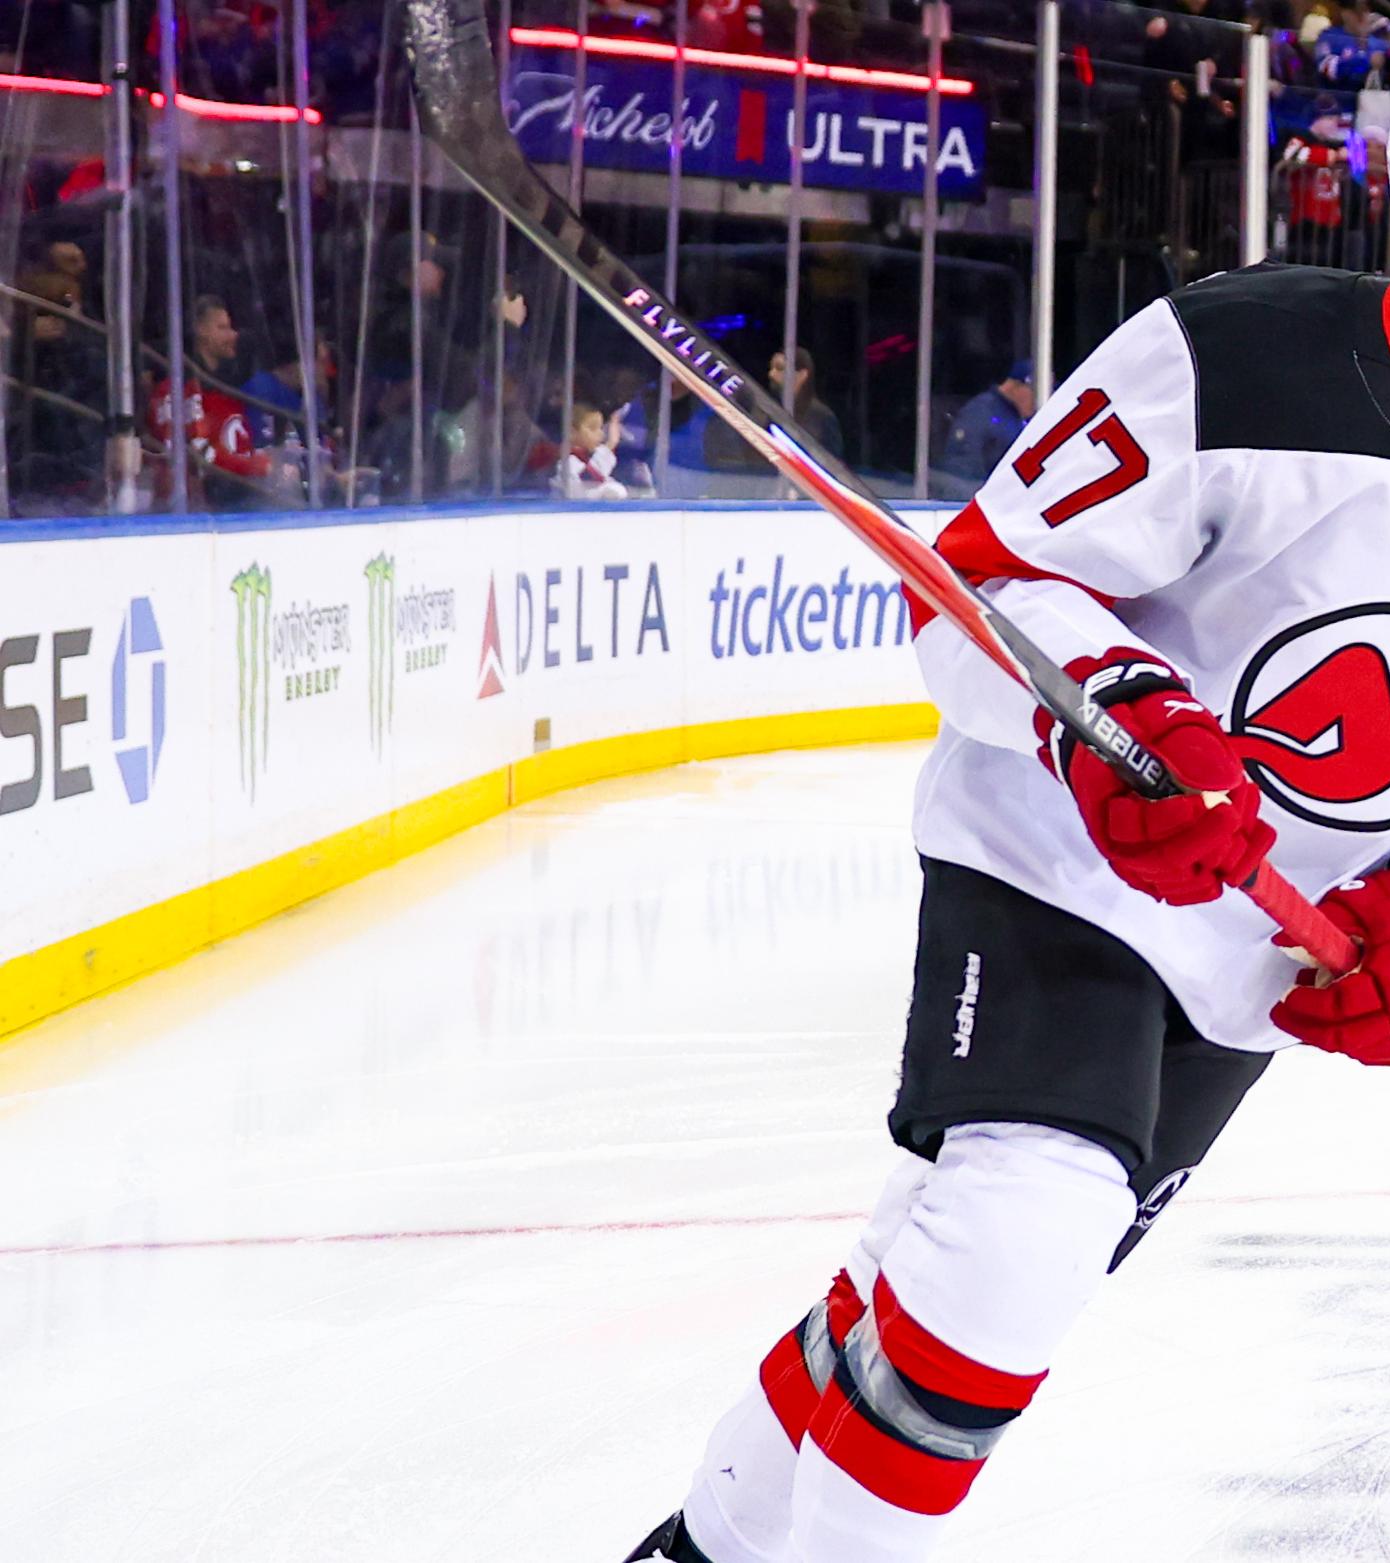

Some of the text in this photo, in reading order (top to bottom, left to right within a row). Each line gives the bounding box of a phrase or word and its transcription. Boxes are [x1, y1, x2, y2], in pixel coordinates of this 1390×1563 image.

[788, 109, 976, 176] ULTRA
[623, 289, 745, 396] FLYLITE
[1012, 388, 1149, 529] 17
[272, 599, 352, 669] MONSTER
[516, 561, 670, 676] DELTA
[709, 555, 907, 659] ticketm
[285, 664, 344, 702] ENERGY
